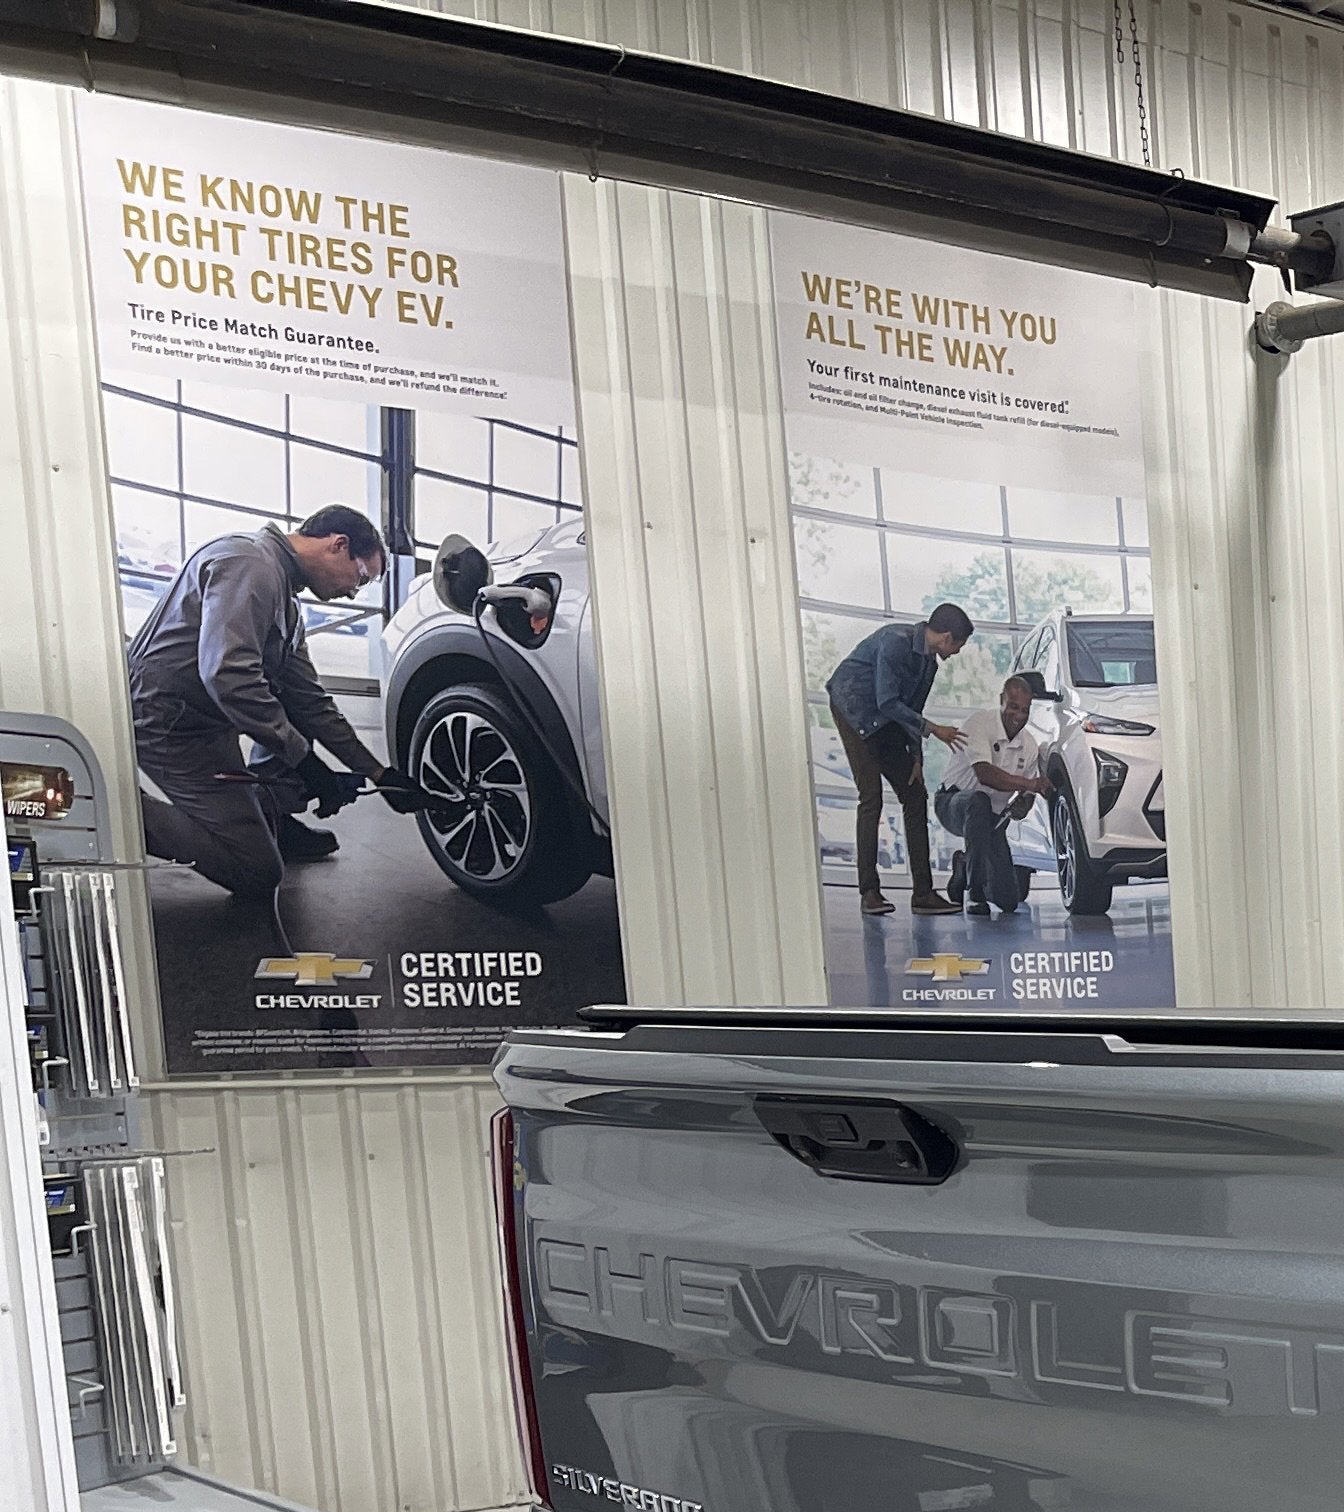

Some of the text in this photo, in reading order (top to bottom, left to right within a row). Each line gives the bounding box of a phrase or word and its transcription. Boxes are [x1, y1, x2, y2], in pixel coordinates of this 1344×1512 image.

[116, 158, 410, 238] WE KNOW THE
[122, 204, 459, 288] RIGHT TIRES FOR
[122, 248, 453, 329] YOUR CHEVY EV.
[128, 303, 380, 353] Tire Price Match Guarantee.
[911, 293, 990, 334] WITH
[1000, 308, 1056, 345] YOU
[806, 312, 1014, 375] ALL THE WAY.
[807, 358, 839, 378] Your
[844, 366, 875, 384] first
[879, 374, 966, 400] maintenance
[969, 389, 997, 404] visit
[1001, 392, 1011, 406] is
[7, 799, 46, 817] WIPERS
[400, 951, 543, 978] CERTIFIED
[1010, 950, 1114, 974] CERTIFIED
[255, 994, 382, 1010] CHEVROLET
[403, 981, 521, 1008] SERVICE
[902, 988, 997, 1001] CHEVROLET
[1011, 976, 1099, 1000] SERVICE
